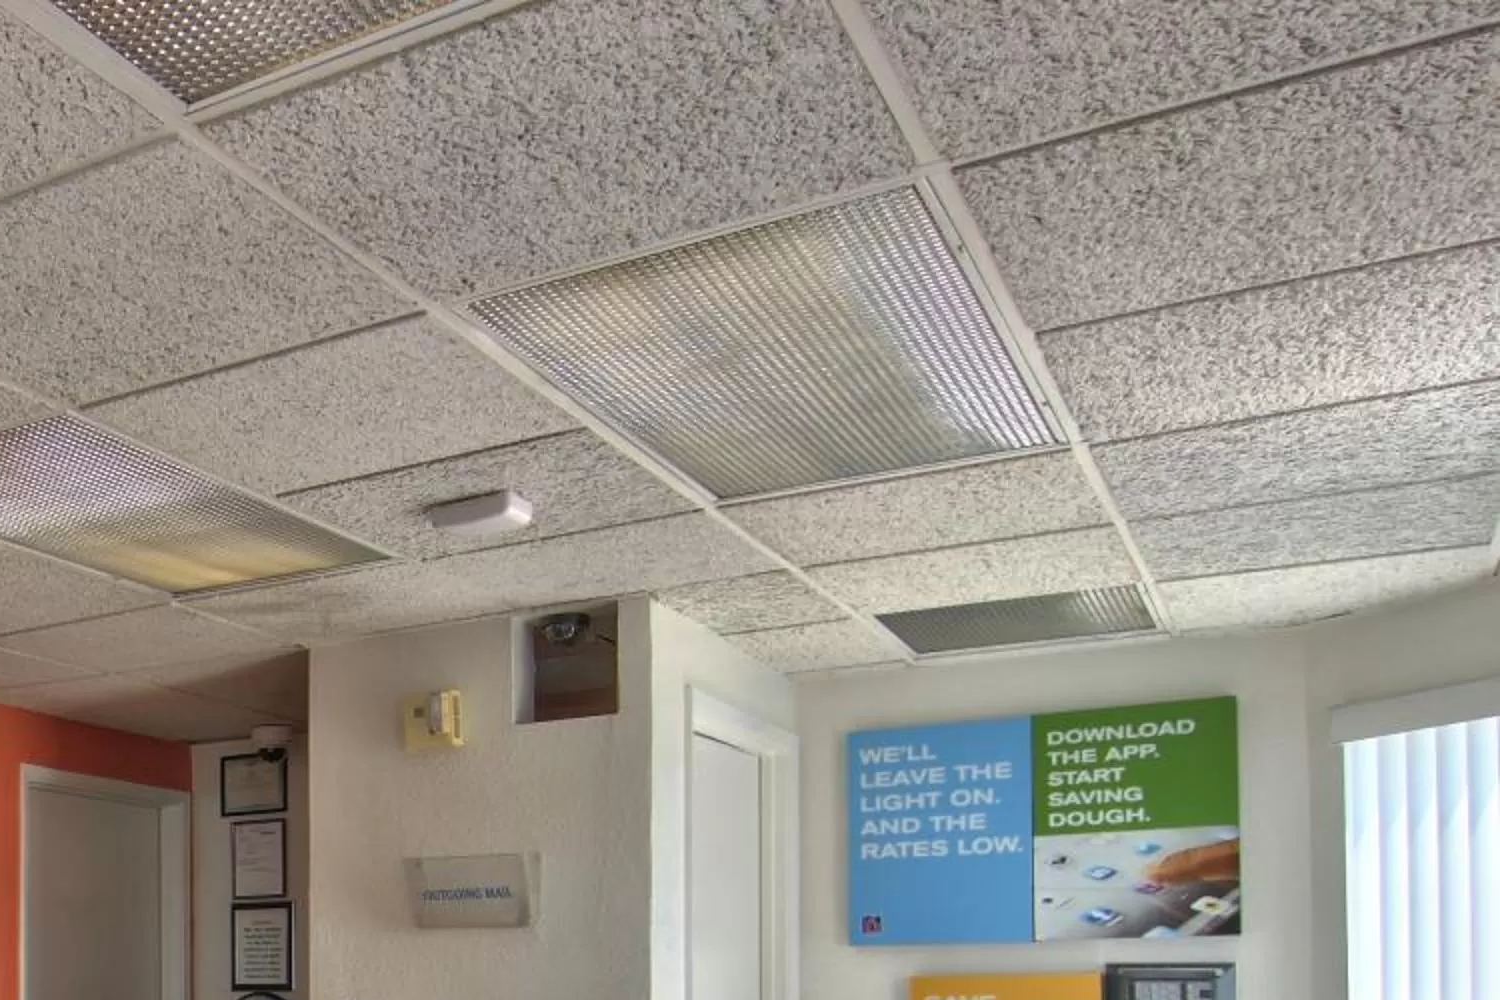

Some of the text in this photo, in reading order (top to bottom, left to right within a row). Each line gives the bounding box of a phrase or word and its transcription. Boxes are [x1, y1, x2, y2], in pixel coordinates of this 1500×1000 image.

[1046, 718, 1196, 746] DOWNLOAD
[859, 744, 937, 765] WE'LL
[1047, 743, 1161, 766] THE APP.
[860, 761, 1013, 789] LEAVE THE
[1047, 767, 1126, 786] START
[860, 787, 1002, 812] LIGHT ON.
[1047, 786, 1144, 806] SAVING
[860, 812, 988, 836] AND THE
[1048, 807, 1151, 828] DOUGH.
[861, 835, 1024, 860] RATES LOW.
